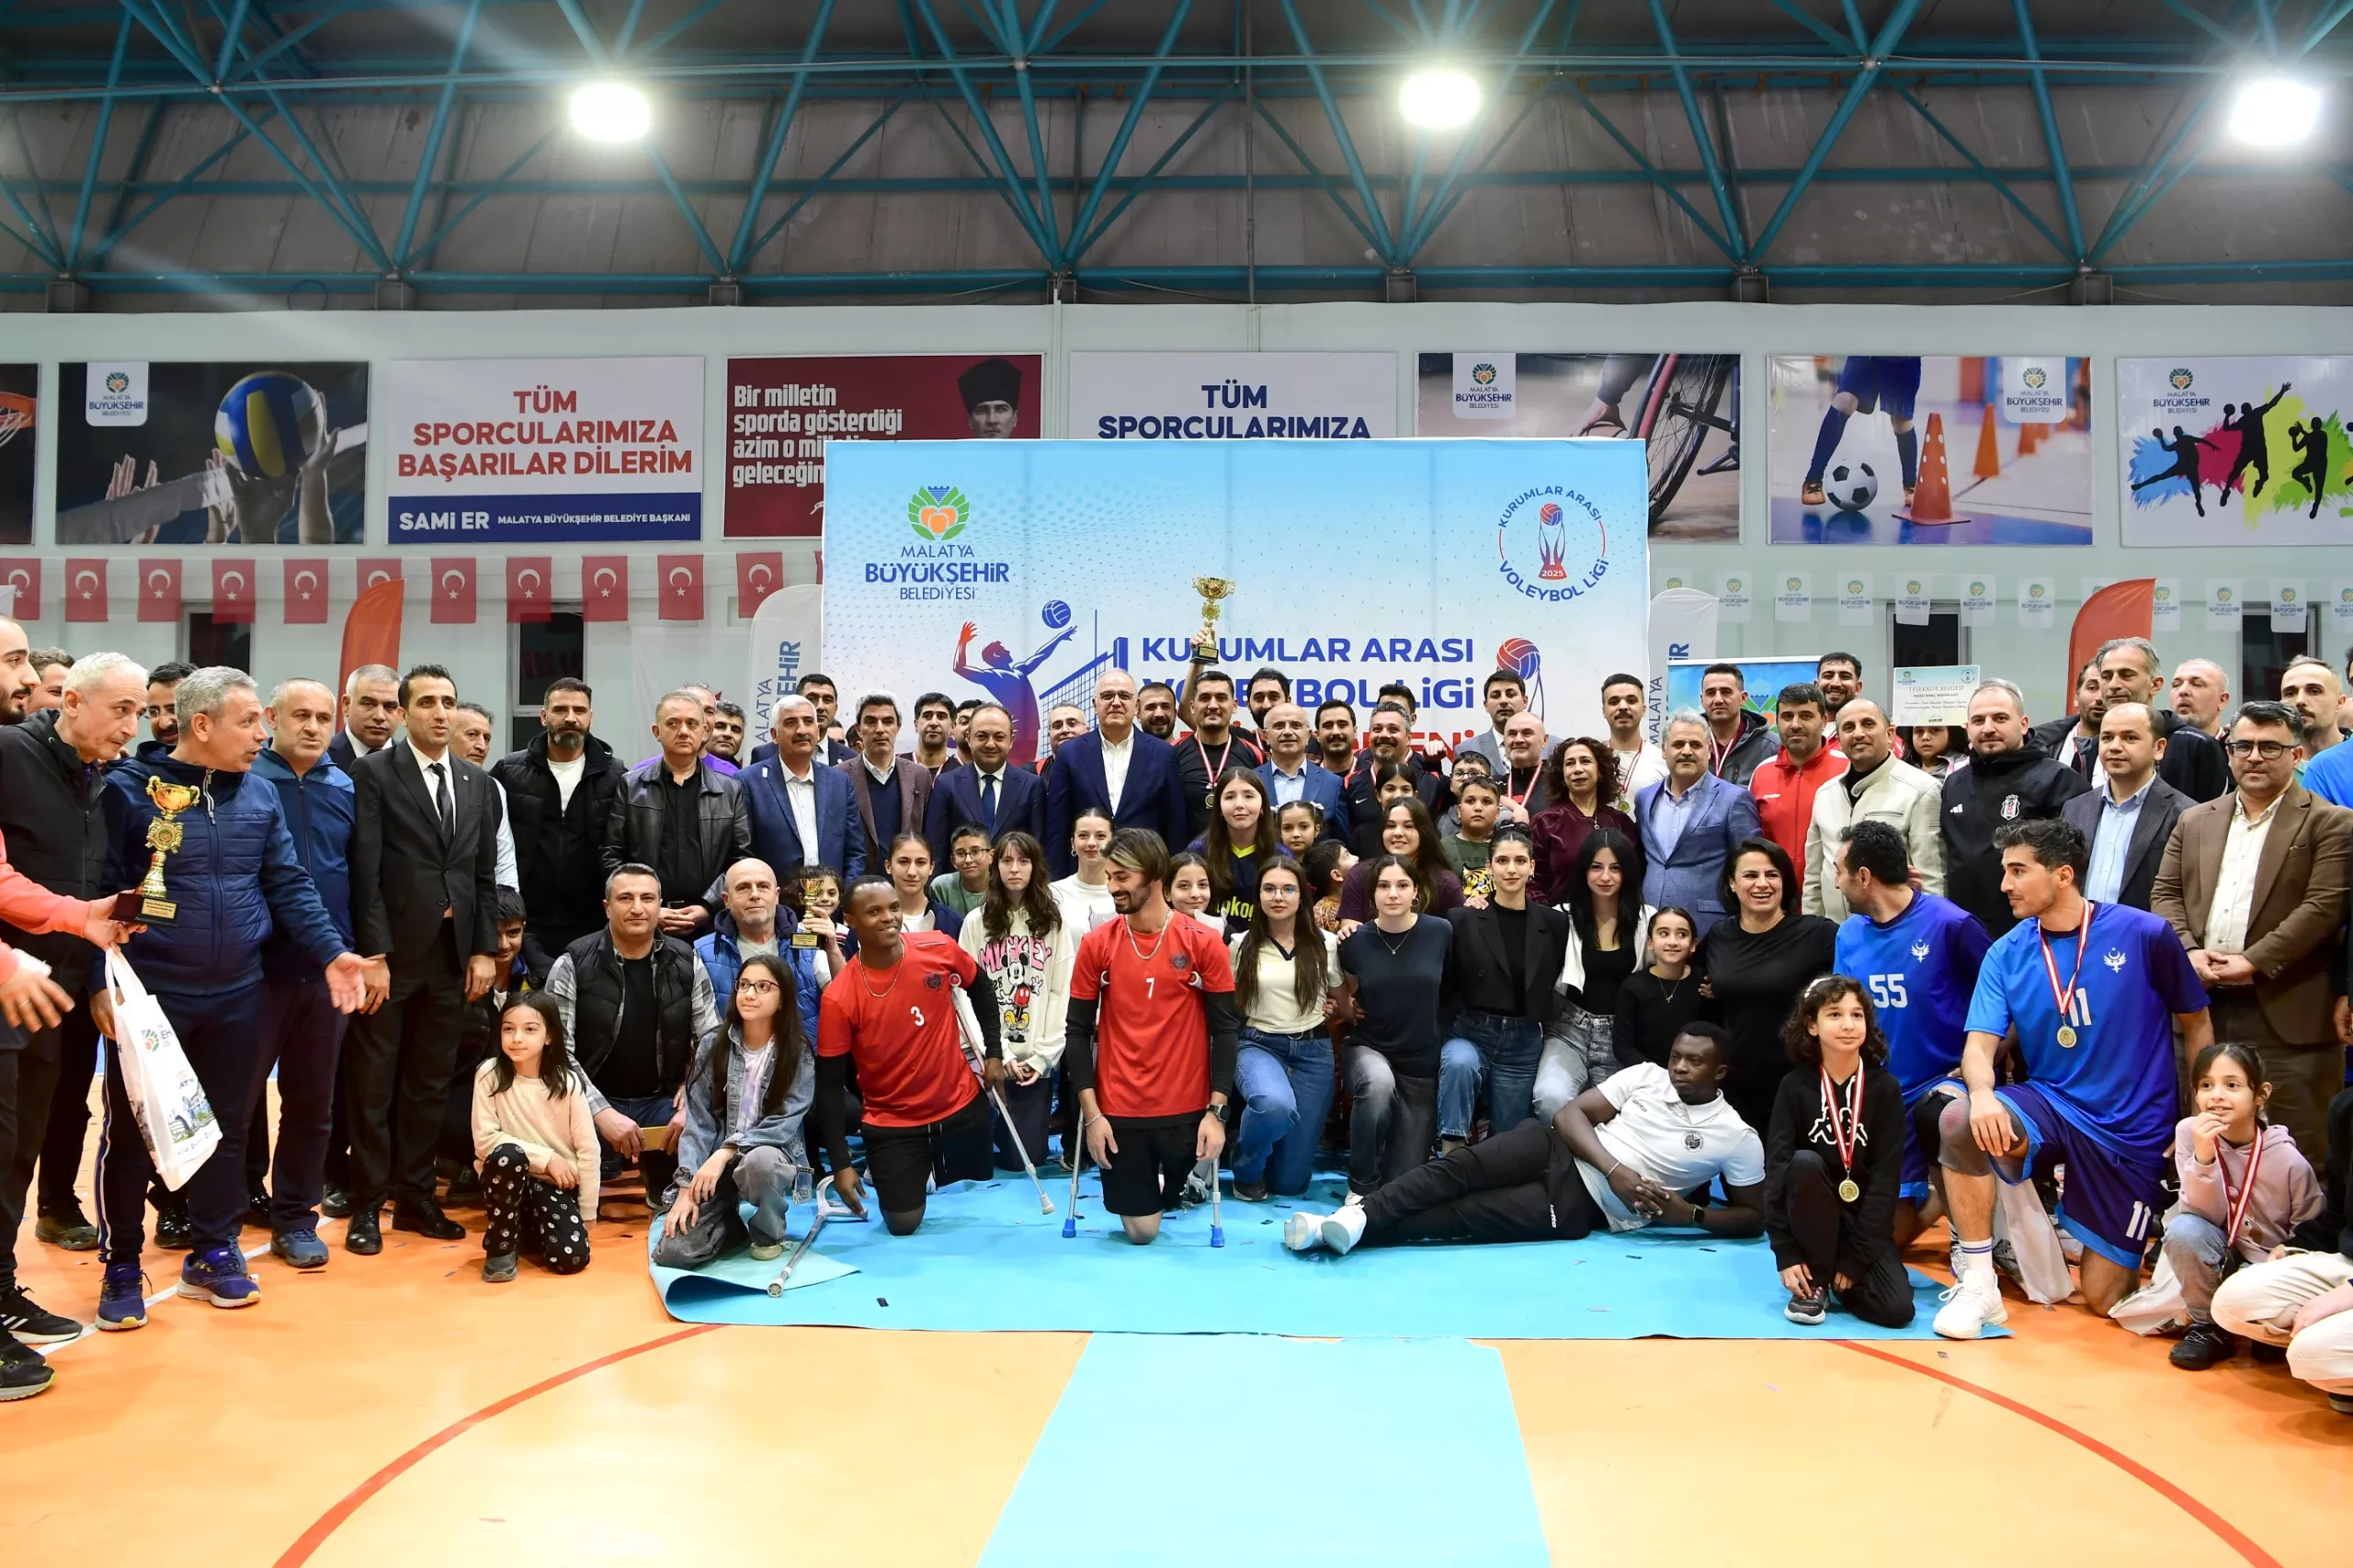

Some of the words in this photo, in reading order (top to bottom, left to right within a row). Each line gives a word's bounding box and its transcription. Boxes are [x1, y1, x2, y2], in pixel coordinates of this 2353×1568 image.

[513, 384, 577, 414] TÜM
[733, 384, 762, 407] Bir
[765, 383, 836, 407] milletin
[1201, 379, 1267, 409] TÜM
[413, 419, 678, 447] SPORCULARIMIZA
[733, 409, 801, 437] sporda
[804, 408, 903, 436] gösterdiği
[1097, 416, 1371, 439] SPORCULARIMIZA
[733, 435, 779, 459] azim
[782, 438, 795, 458] o
[397, 450, 567, 483] BAŞARILAR
[574, 444, 692, 474] DİLERİM
[461, 511, 490, 530] ER
[497, 515, 542, 524] MALATYA
[649, 512, 691, 525] BAŞKANI
[1498, 485, 1563, 528] KURUMLAR
[1565, 489, 1602, 521] ARASI
[901, 544, 975, 558] MALATYA
[1499, 560, 1585, 602] VOLEYBOL
[1142, 637, 1351, 663] KUUMLAR
[1360, 638, 1473, 663] ARASI
[755, 677, 773, 744] ALATYA
[979, 934, 1052, 973] MICKEY
[1145, 977, 1155, 999] 7
[1869, 973, 1908, 1008] 55
[910, 1006, 925, 1027] 3
[2068, 987, 2092, 1028] 11
[2125, 1200, 2152, 1241] 11
